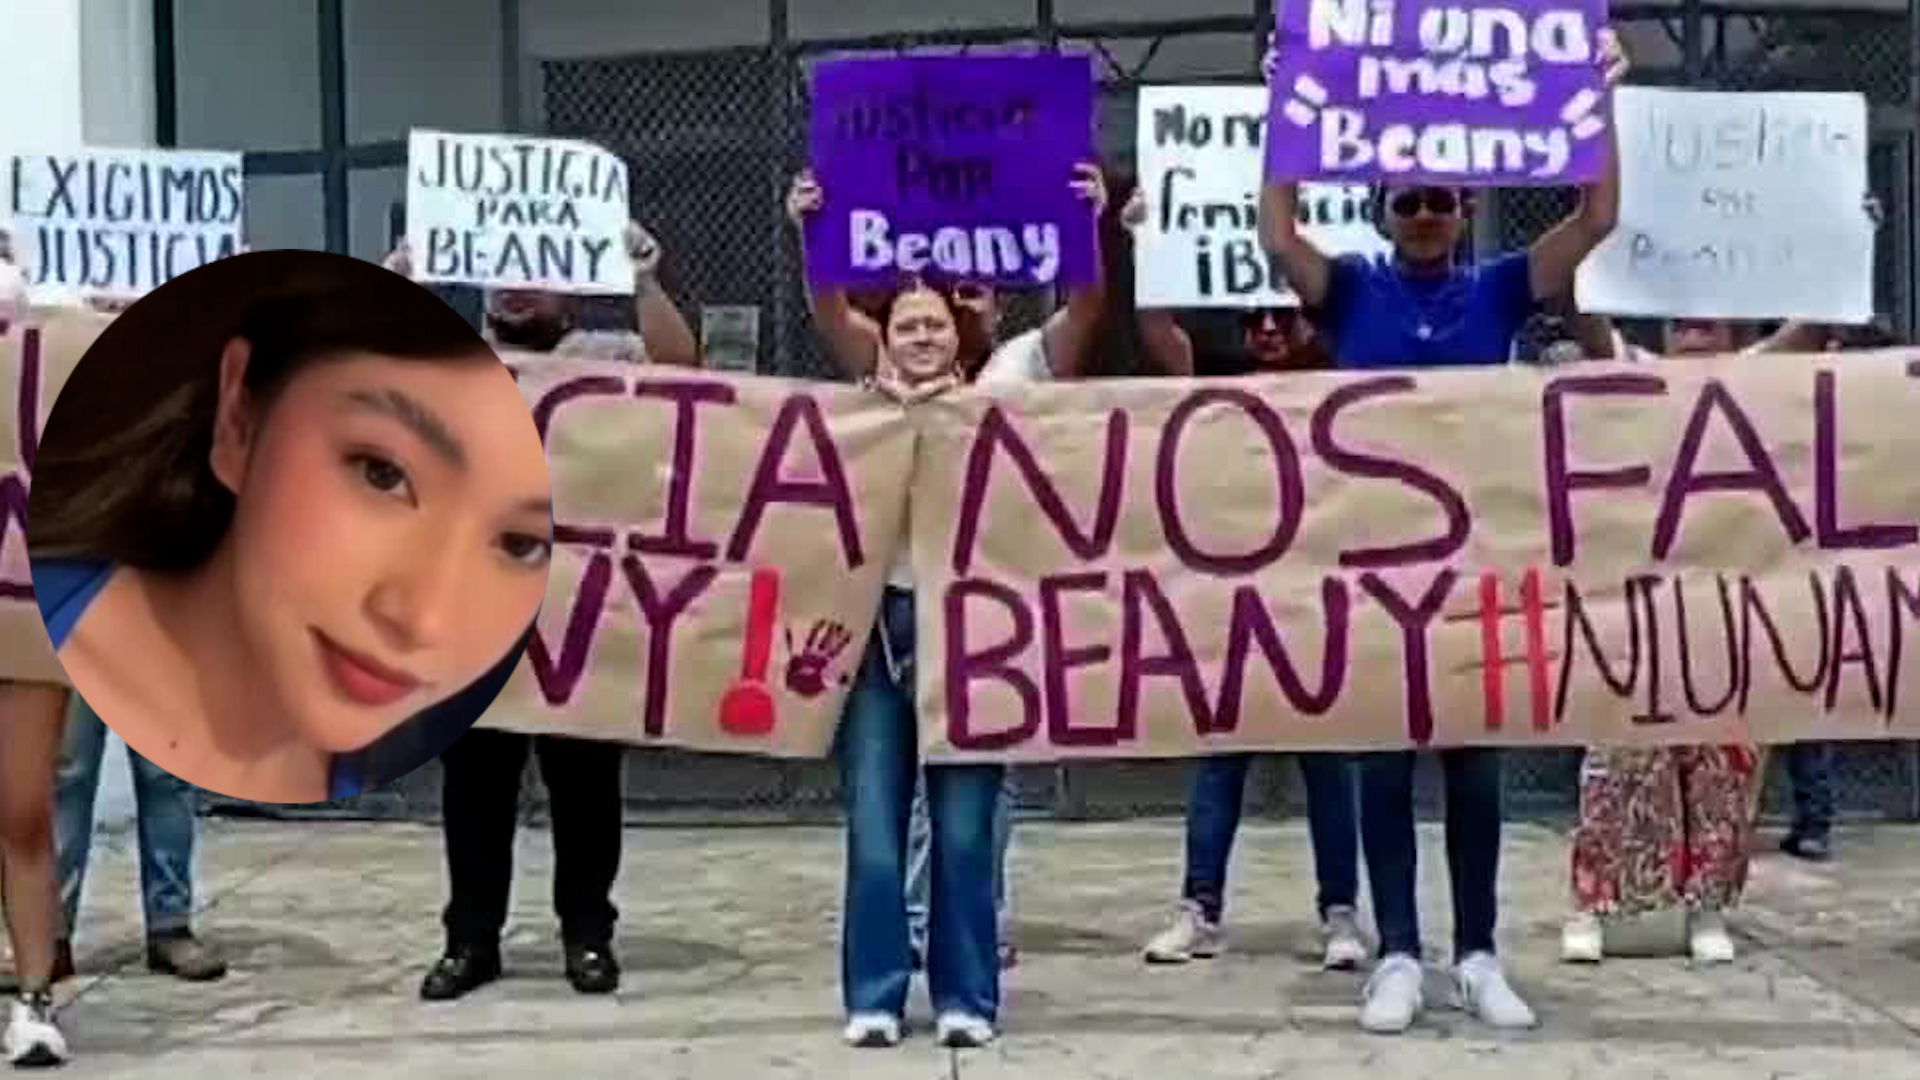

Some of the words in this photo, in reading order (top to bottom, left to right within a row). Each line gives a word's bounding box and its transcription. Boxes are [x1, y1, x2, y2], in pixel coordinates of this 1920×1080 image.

[1309, 0, 1393, 50] Ni
[1419, 7, 1590, 63] una
[418, 138, 626, 204] JUSTICIA
[477, 198, 581, 230] PARA
[849, 208, 1061, 283] Beany
[426, 228, 611, 282] BEANY
[952, 375, 1471, 576] NOS
[1543, 360, 1920, 567] FAL
[944, 567, 1458, 751] BEANY
